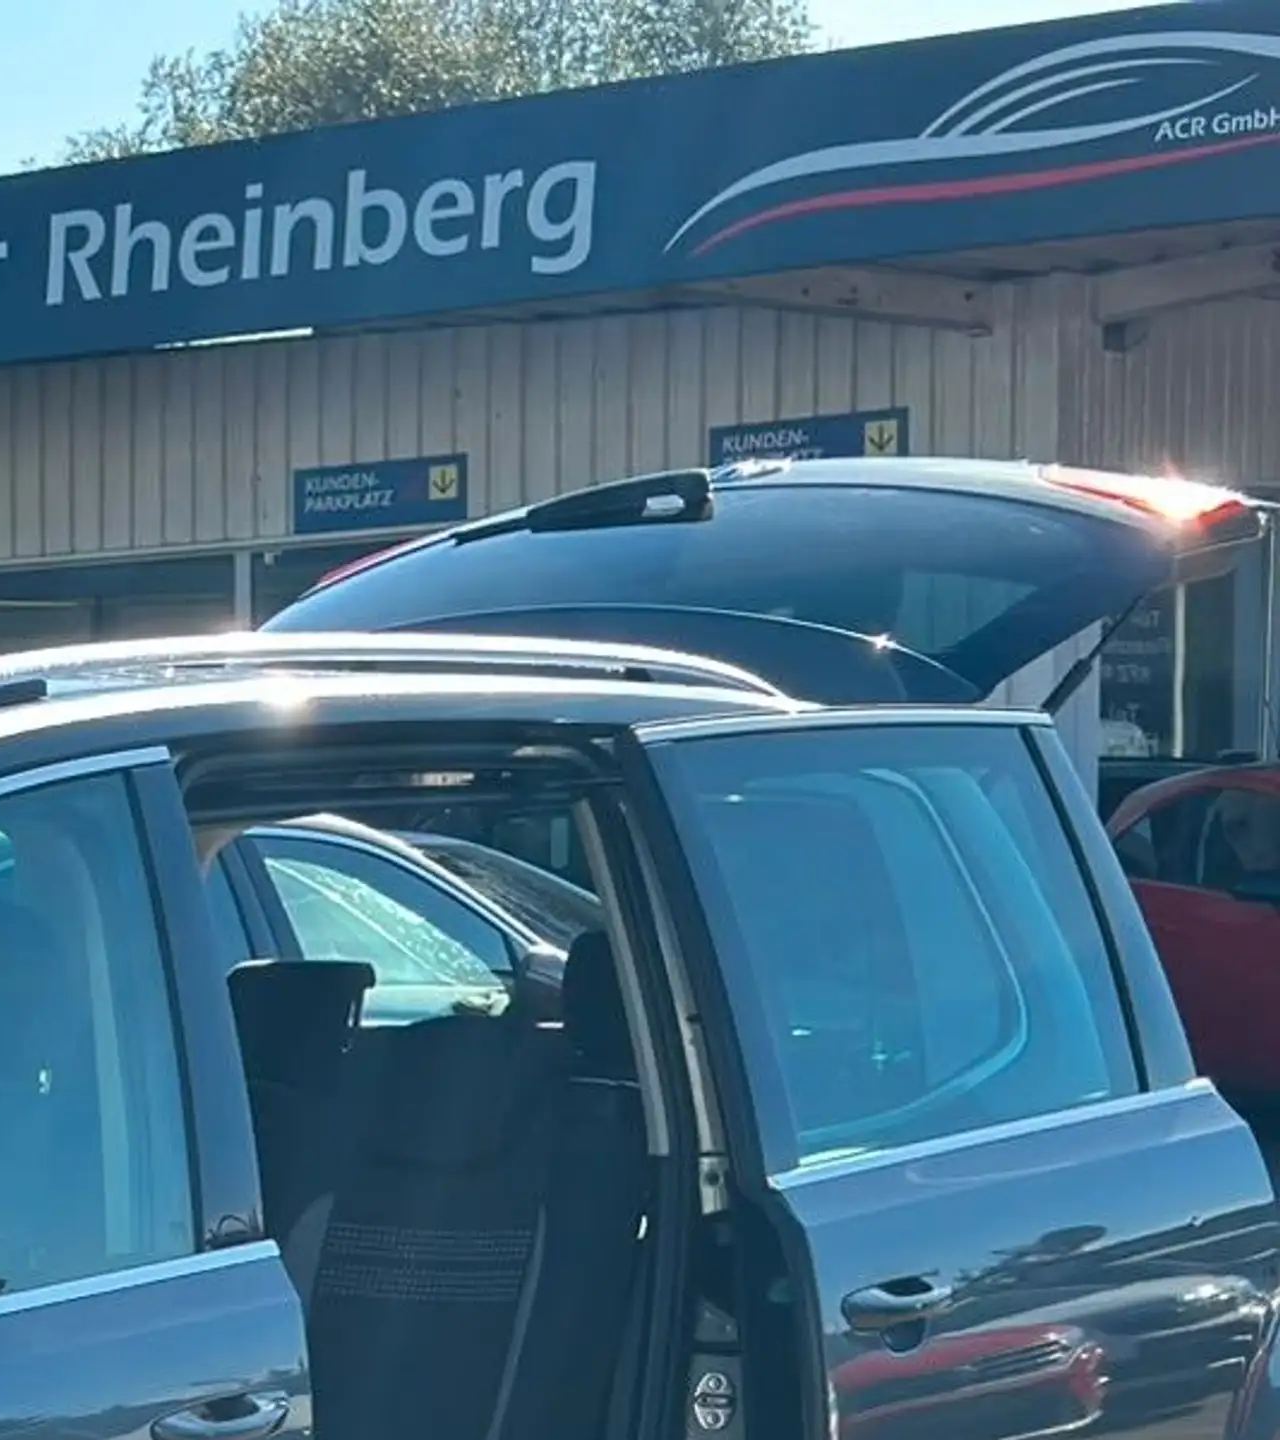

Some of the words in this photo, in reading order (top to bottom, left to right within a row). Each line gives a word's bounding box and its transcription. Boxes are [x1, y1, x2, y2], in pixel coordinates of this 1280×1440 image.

[1154, 116, 1206, 142] ACR
[45, 160, 597, 307] Rheinberg
[722, 428, 809, 453] KUNDEN-
[305, 471, 380, 494] KUNDEN-
[304, 490, 394, 513] PARKPLATZ
